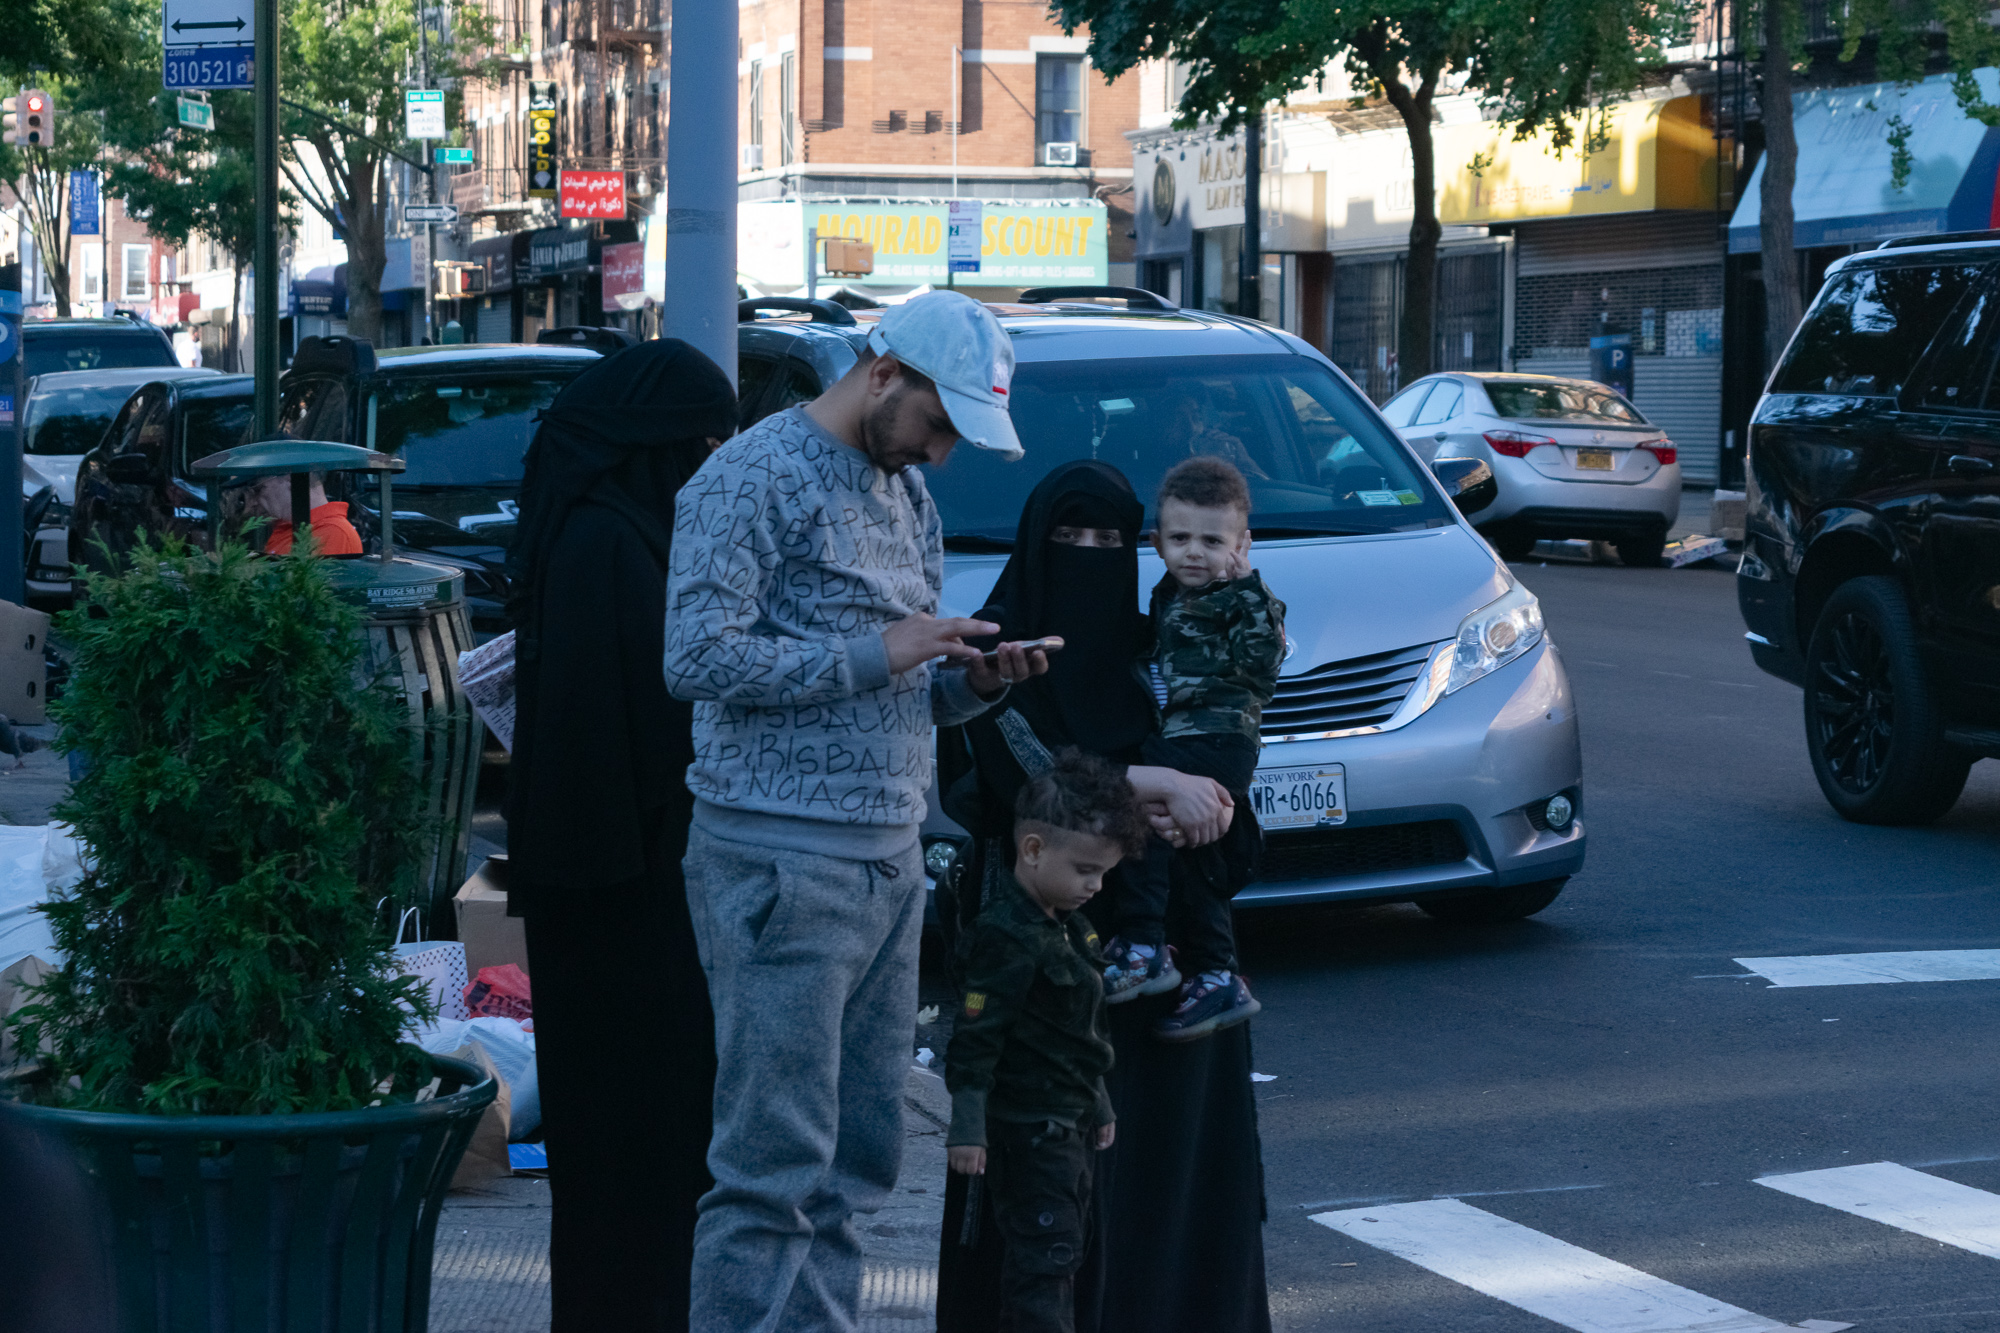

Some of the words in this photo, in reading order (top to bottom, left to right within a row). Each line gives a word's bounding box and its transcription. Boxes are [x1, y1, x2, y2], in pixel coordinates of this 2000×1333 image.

[168, 60, 232, 84] 310521
[534, 117, 551, 171] GOLD
[1198, 143, 1265, 184] MASO
[73, 176, 82, 220] WELCOME
[1206, 186, 1231, 211] LAW
[435, 210, 451, 218] WAY
[816, 214, 943, 255] MOURAD
[981, 215, 1094, 256] SCOUNT
[1612, 349, 1624, 367] P
[368, 588, 382, 597] BAY
[383, 587, 405, 596] RIDGE
[417, 584, 438, 594] AVENUE
[1260, 772, 1284, 784] NEW
[1286, 771, 1316, 783] YORK
[1252, 786, 1276, 815] WR
[1290, 781, 1337, 812] 6066
[1264, 814, 1315, 825] EXCELSIOR
